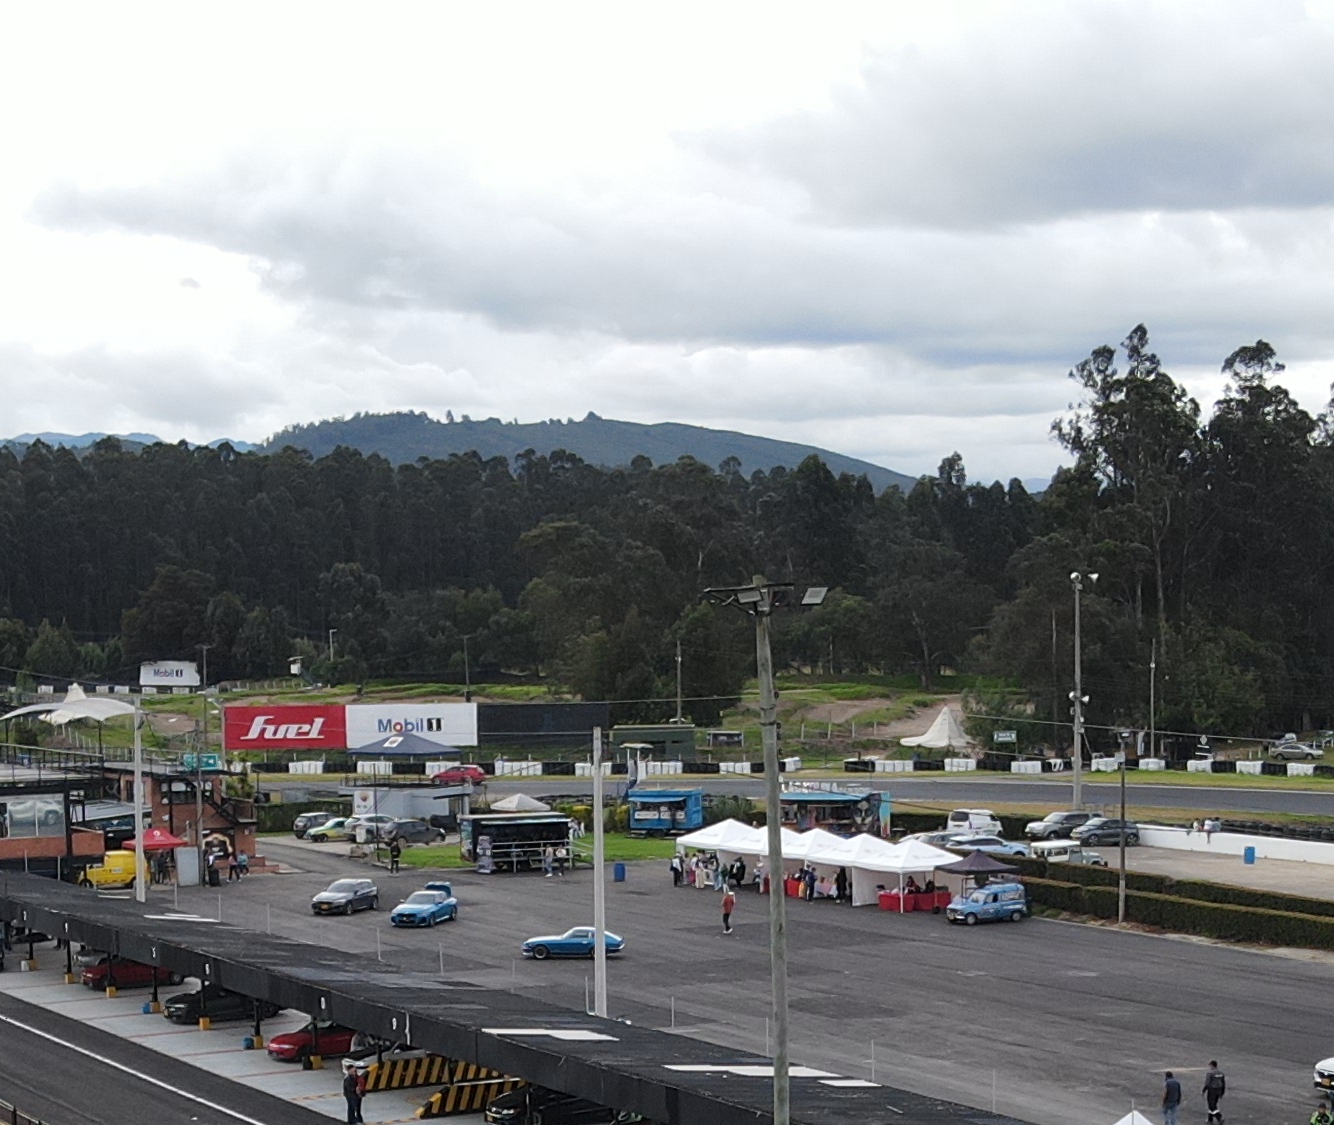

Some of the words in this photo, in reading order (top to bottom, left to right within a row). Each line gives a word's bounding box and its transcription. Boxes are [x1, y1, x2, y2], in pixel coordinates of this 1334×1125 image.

[153, 669, 174, 677] Mobil
[378, 719, 424, 733] Mobil
[427, 717, 441, 732] 1
